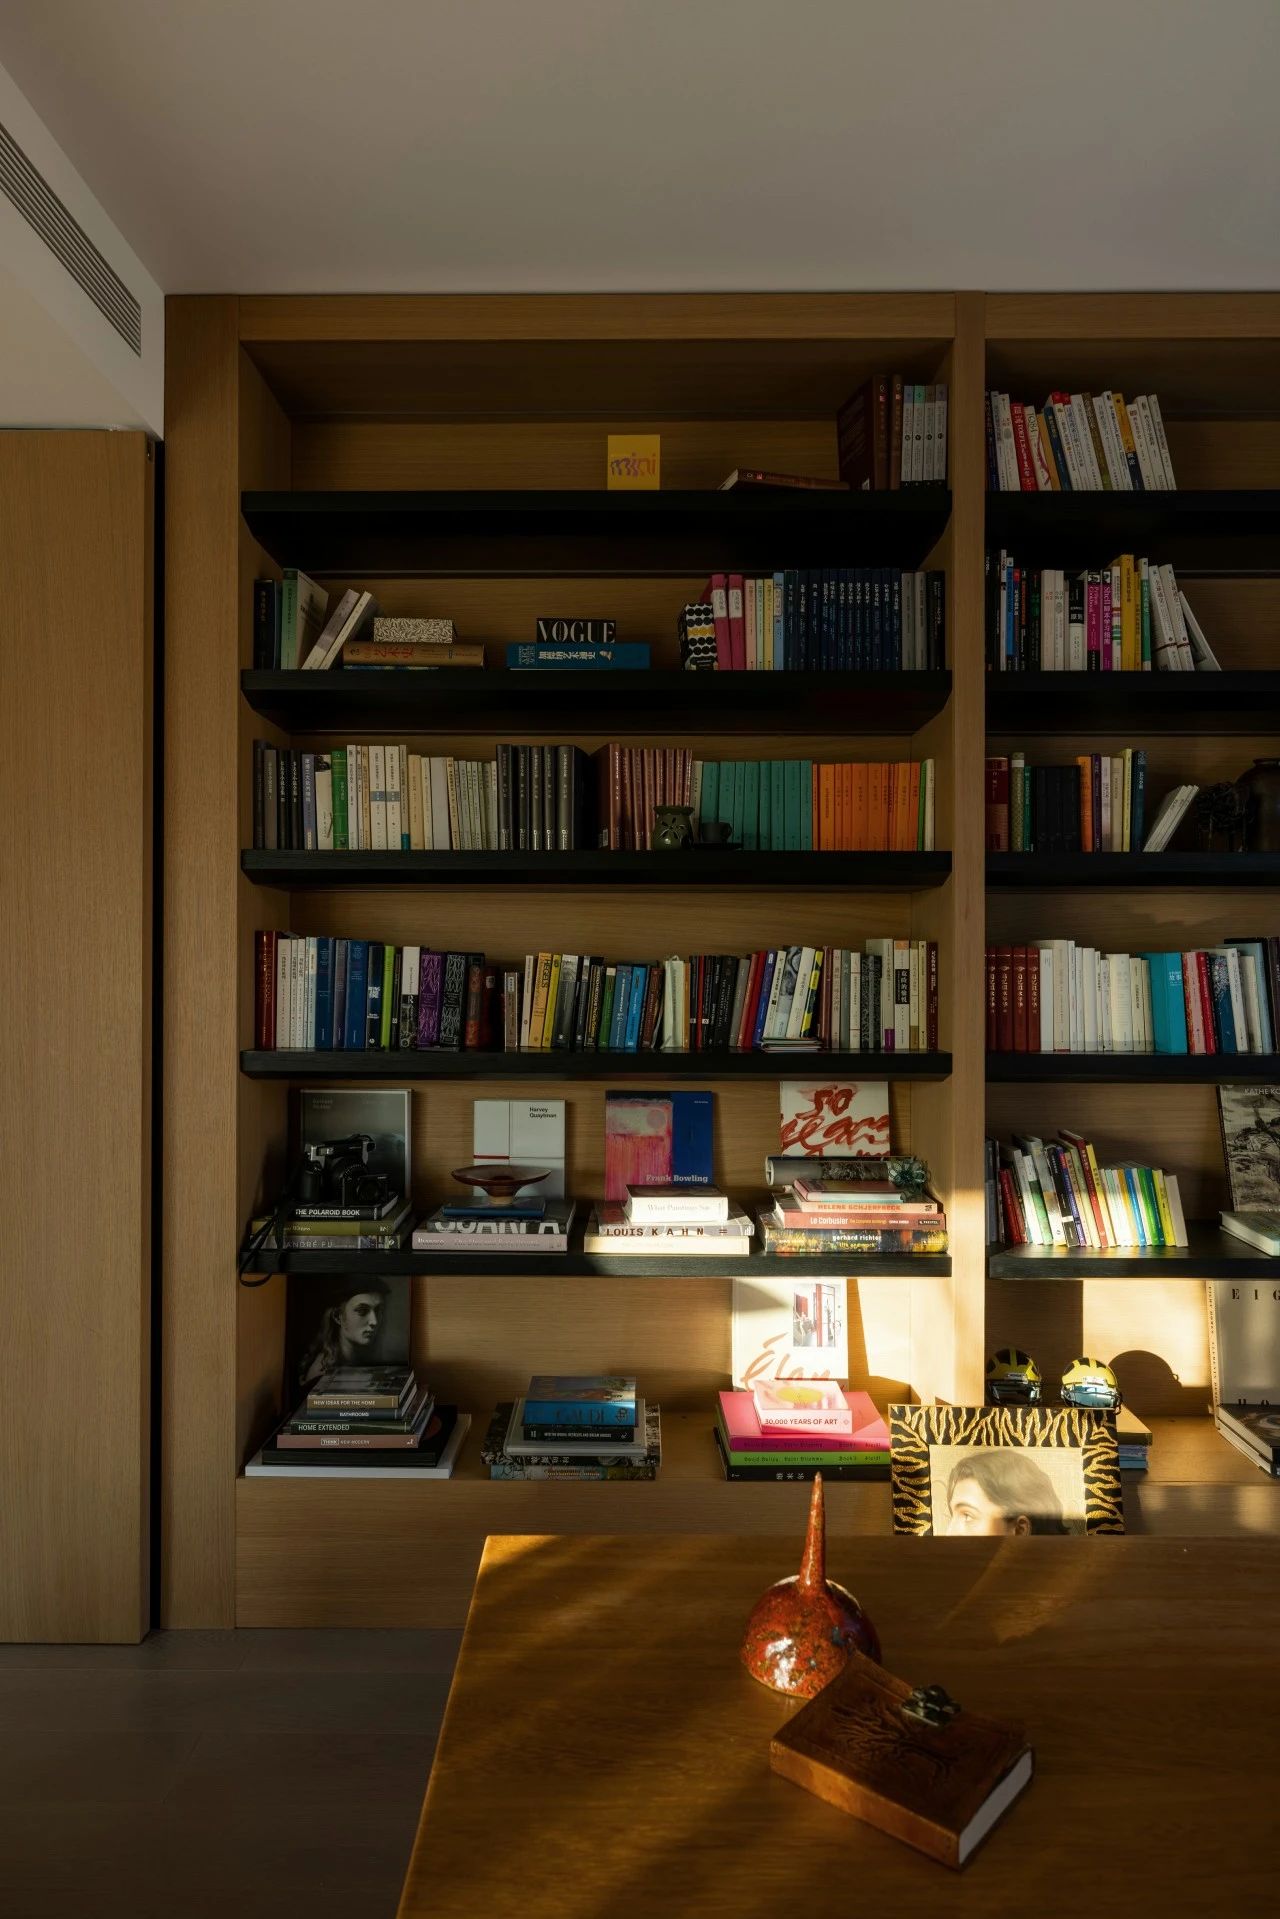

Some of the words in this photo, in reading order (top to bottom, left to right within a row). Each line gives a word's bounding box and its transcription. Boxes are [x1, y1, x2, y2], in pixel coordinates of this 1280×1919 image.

[538, 620, 615, 643] VOGUE
[646, 1174, 671, 1183] Frank
[673, 1174, 708, 1183] Bowling
[819, 1216, 848, 1224] Corbusier
[606, 1228, 643, 1236] LOUIS
[833, 1234, 857, 1243] gerhard
[321, 1240, 333, 1248] FU
